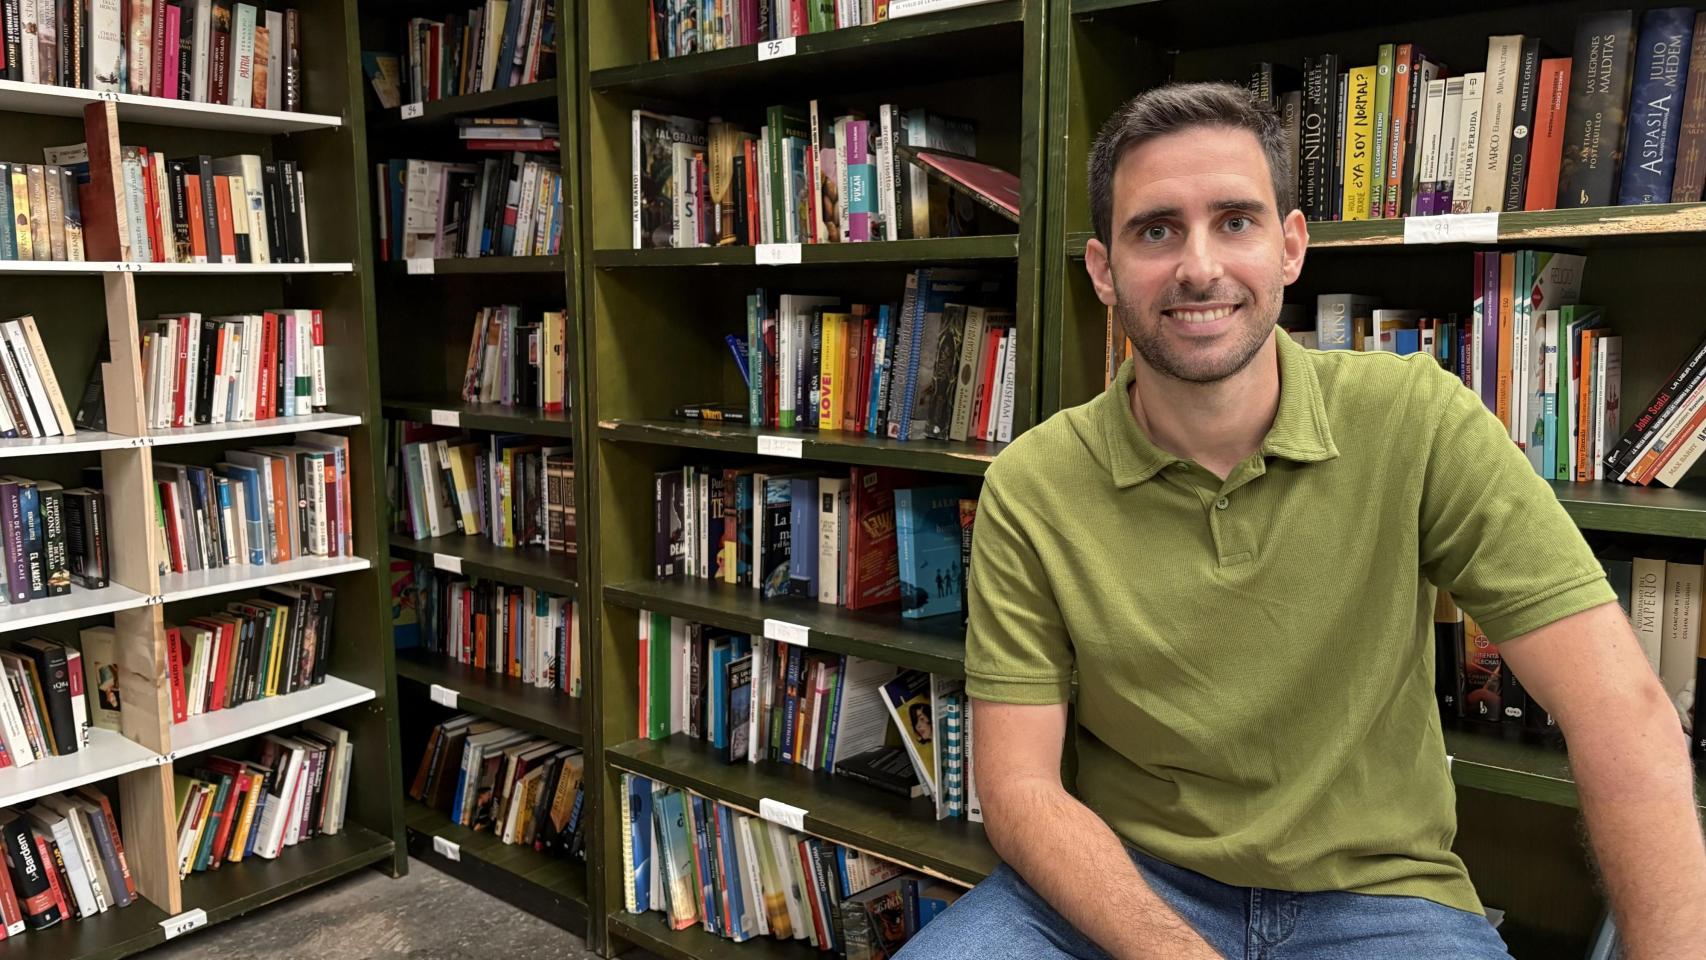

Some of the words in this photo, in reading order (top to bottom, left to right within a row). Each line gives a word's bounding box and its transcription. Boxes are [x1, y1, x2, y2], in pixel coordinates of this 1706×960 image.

[7, 34, 14, 43] LA
[767, 41, 783, 56] 95
[1588, 35, 1600, 78] LEGIONES
[1600, 34, 1615, 94] MALDITAS
[1650, 42, 1667, 81] JULIO
[1665, 35, 1682, 88] MEDEM
[1314, 64, 1323, 104] NEGRETE
[1353, 74, 1369, 126] NORMAL?
[1521, 81, 1531, 112] ARLETTE
[1586, 80, 1595, 94] LAS
[882, 125, 891, 154] arroces
[1305, 113, 1322, 160] NILO
[1353, 132, 1366, 158] SOY
[1468, 110, 1478, 149] PERDIDA
[1581, 120, 1592, 163] SANTIAGO
[1589, 112, 1602, 169] POSTEGUILLO
[1640, 94, 1672, 175] ASPASIA
[1466, 152, 1475, 182] TUMBA
[1487, 134, 1500, 171] MARCO
[1352, 164, 1365, 189] ¿YA
[1464, 186, 1470, 196] LA
[1507, 154, 1522, 211] VINDICATIO
[1306, 196, 1314, 207] LA
[1435, 224, 1449, 235] 99
[1333, 303, 1345, 344] KING
[810, 375, 819, 405] CABAÑA
[821, 377, 831, 418] LOVE
[1002, 372, 1014, 419] GRISHAM
[1634, 412, 1652, 432] John
[1648, 392, 1670, 415] Scalzi
[1671, 381, 1679, 390] LA
[1668, 461, 1682, 476] MAX
[14, 520, 20, 528] DE
[45, 496, 55, 538] FALCONES
[53, 499, 61, 534] ILDEFONSO
[774, 513, 786, 526] La
[54, 546, 59, 555] DE
[780, 530, 791, 540] m
[30, 552, 39, 561] EL
[54, 555, 60, 563] LA
[31, 562, 42, 591] ALMACÉN
[1642, 573, 1657, 633] IMPERIO
[17, 832, 36, 874] Bardem
